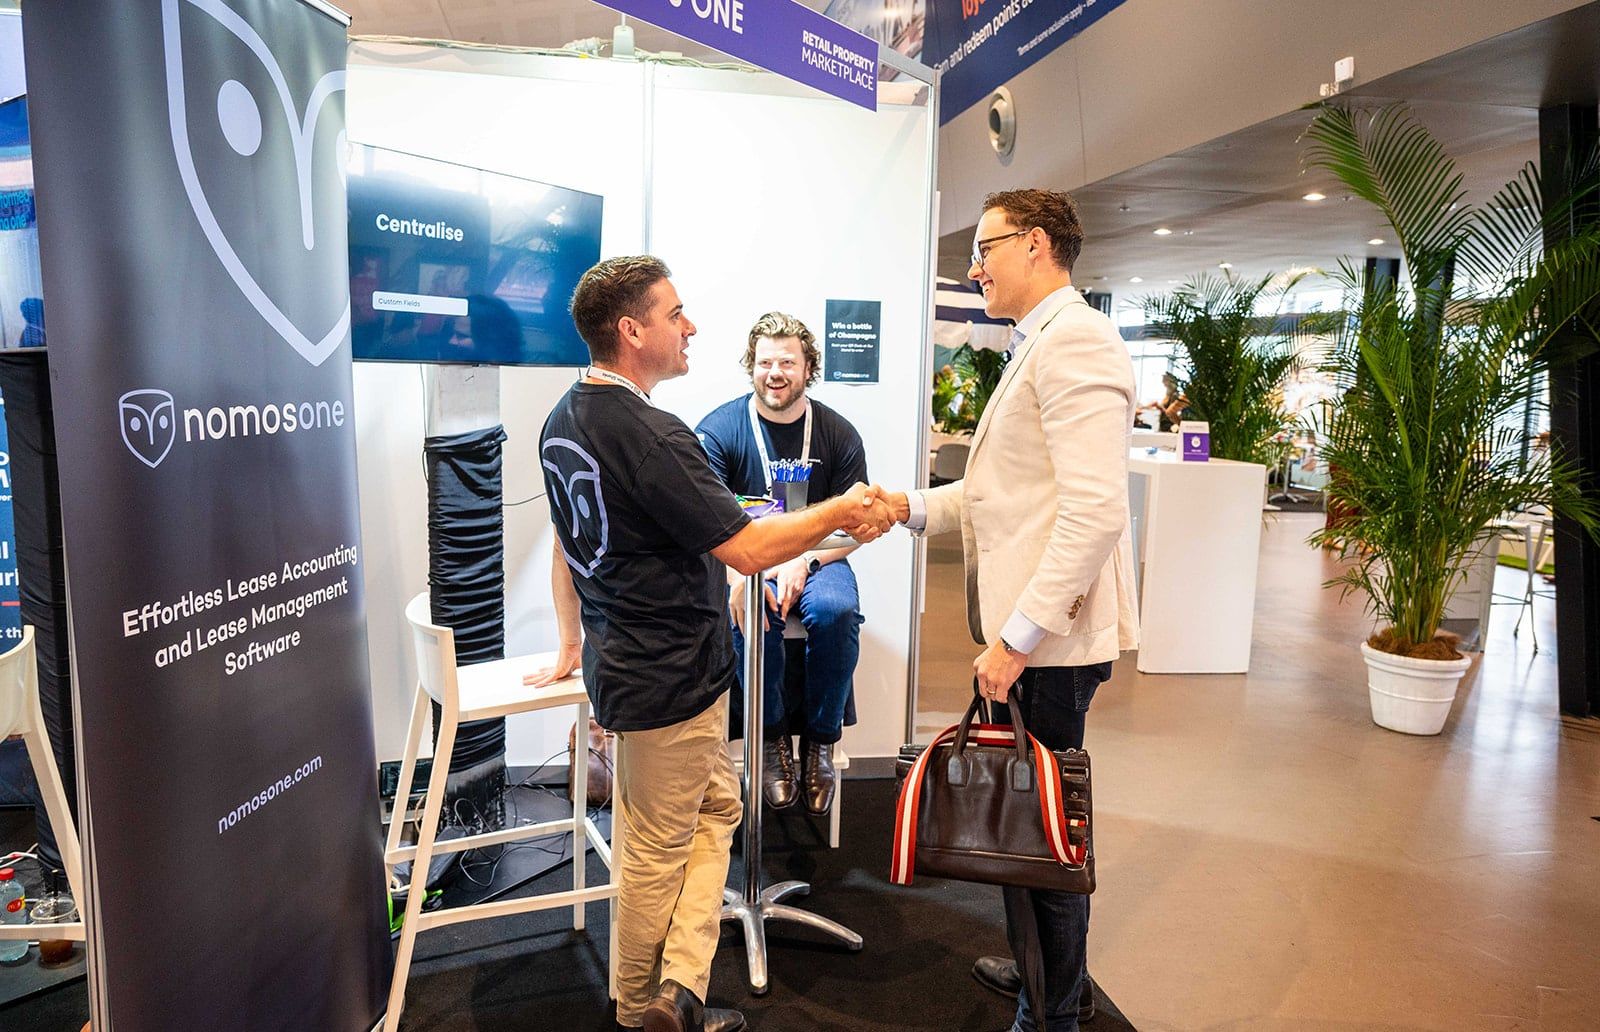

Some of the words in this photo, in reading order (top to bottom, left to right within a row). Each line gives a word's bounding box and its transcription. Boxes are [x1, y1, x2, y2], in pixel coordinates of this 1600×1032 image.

[691, 0, 744, 34] ONE
[950, 43, 963, 68] and
[963, 22, 992, 56] redeem
[993, 0, 1021, 36] points
[801, 46, 874, 91] MARKETPLACE
[802, 30, 833, 55] RETAIL
[833, 44, 875, 73] PROPERTY
[376, 213, 464, 241] Centralise
[837, 332, 877, 340] Champagne
[183, 400, 345, 442] nomosone
[122, 588, 223, 637] Effortless
[227, 571, 277, 601] Lease
[280, 544, 357, 584] Accounting
[154, 632, 192, 668] and
[196, 615, 247, 651] Lease
[251, 577, 348, 629] Management
[224, 631, 301, 676] Software
[218, 755, 322, 834] nomosone.com
